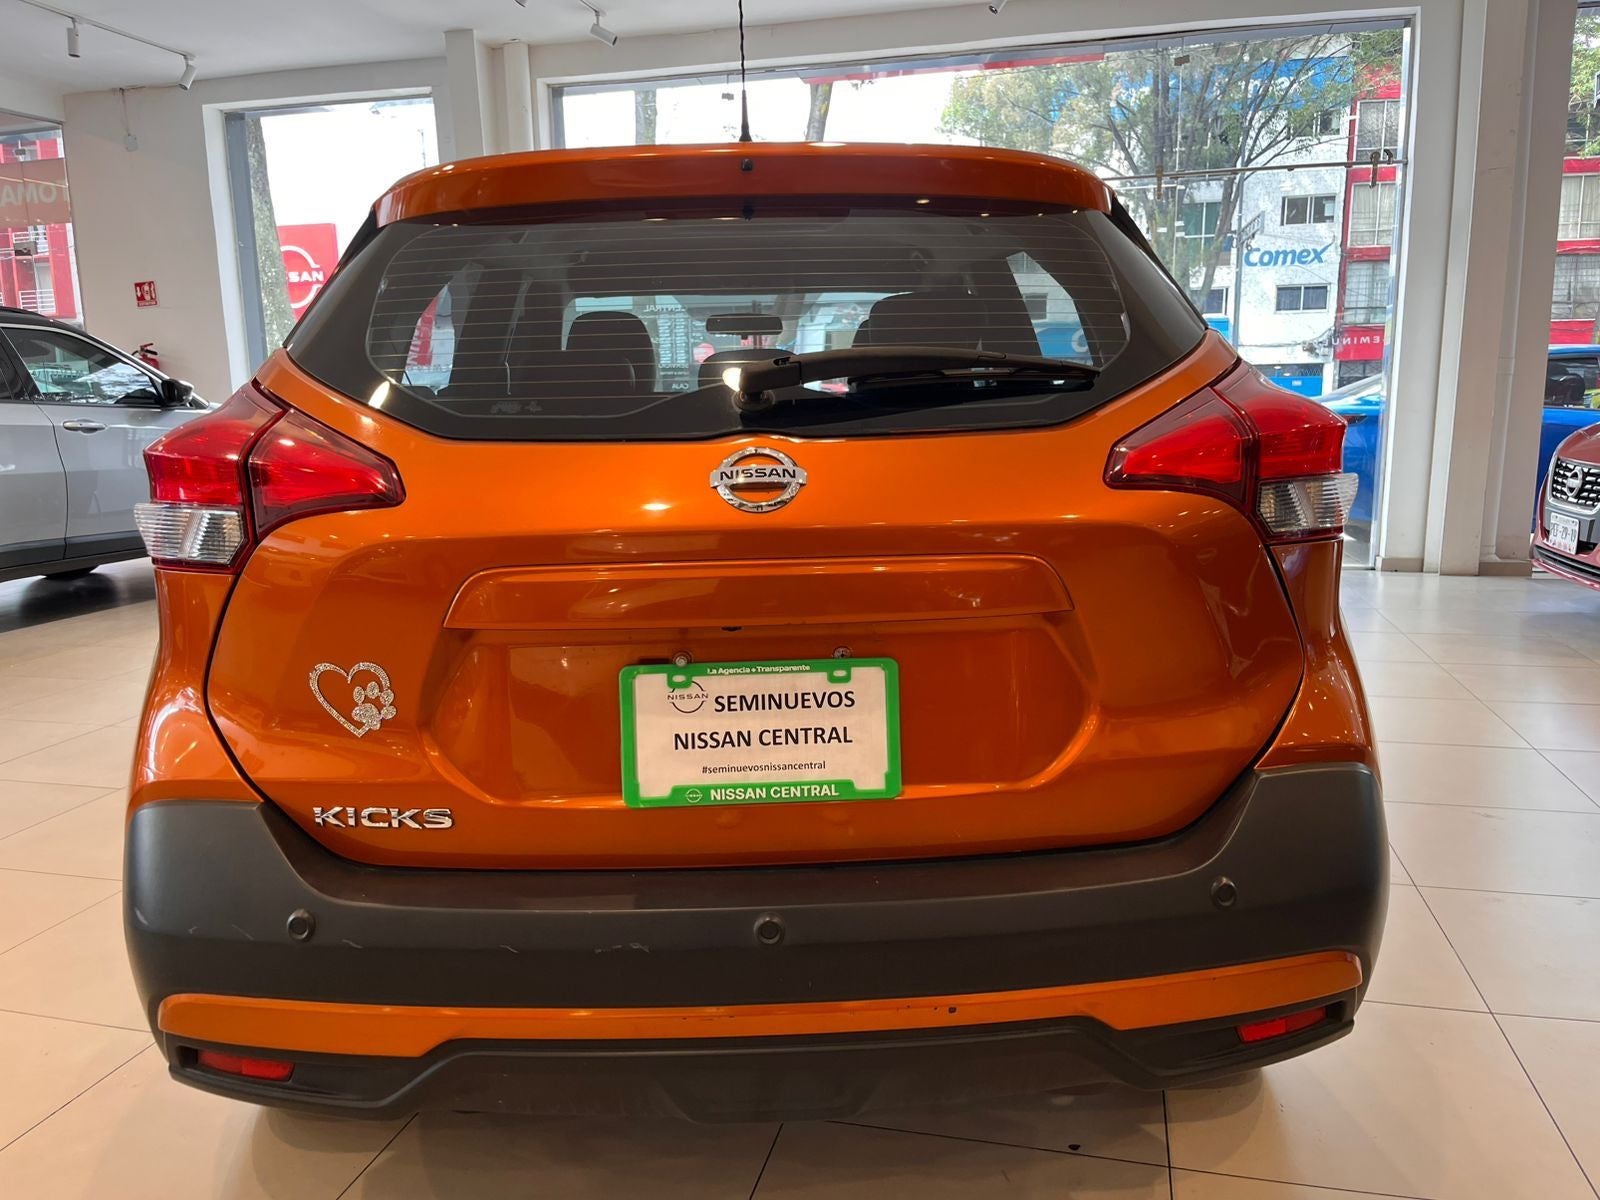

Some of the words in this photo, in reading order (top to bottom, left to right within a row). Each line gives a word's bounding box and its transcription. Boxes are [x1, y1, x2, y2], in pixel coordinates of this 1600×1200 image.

[1244, 242, 1331, 267] Comex
[287, 271, 324, 282] SAN
[720, 467, 796, 480] NISSAN
[718, 666, 751, 675] Agencia
[756, 664, 811, 673] Transparente
[667, 692, 709, 700] NISSAN
[714, 690, 856, 713] SEMINUEVOS
[673, 730, 752, 750] NISSAN
[758, 726, 854, 746] CENTRAL
[702, 760, 826, 774] #seminuevosnissancentral
[710, 787, 767, 801] NISSAN
[770, 784, 840, 799] CENTRAL
[312, 806, 453, 829] KICKS
